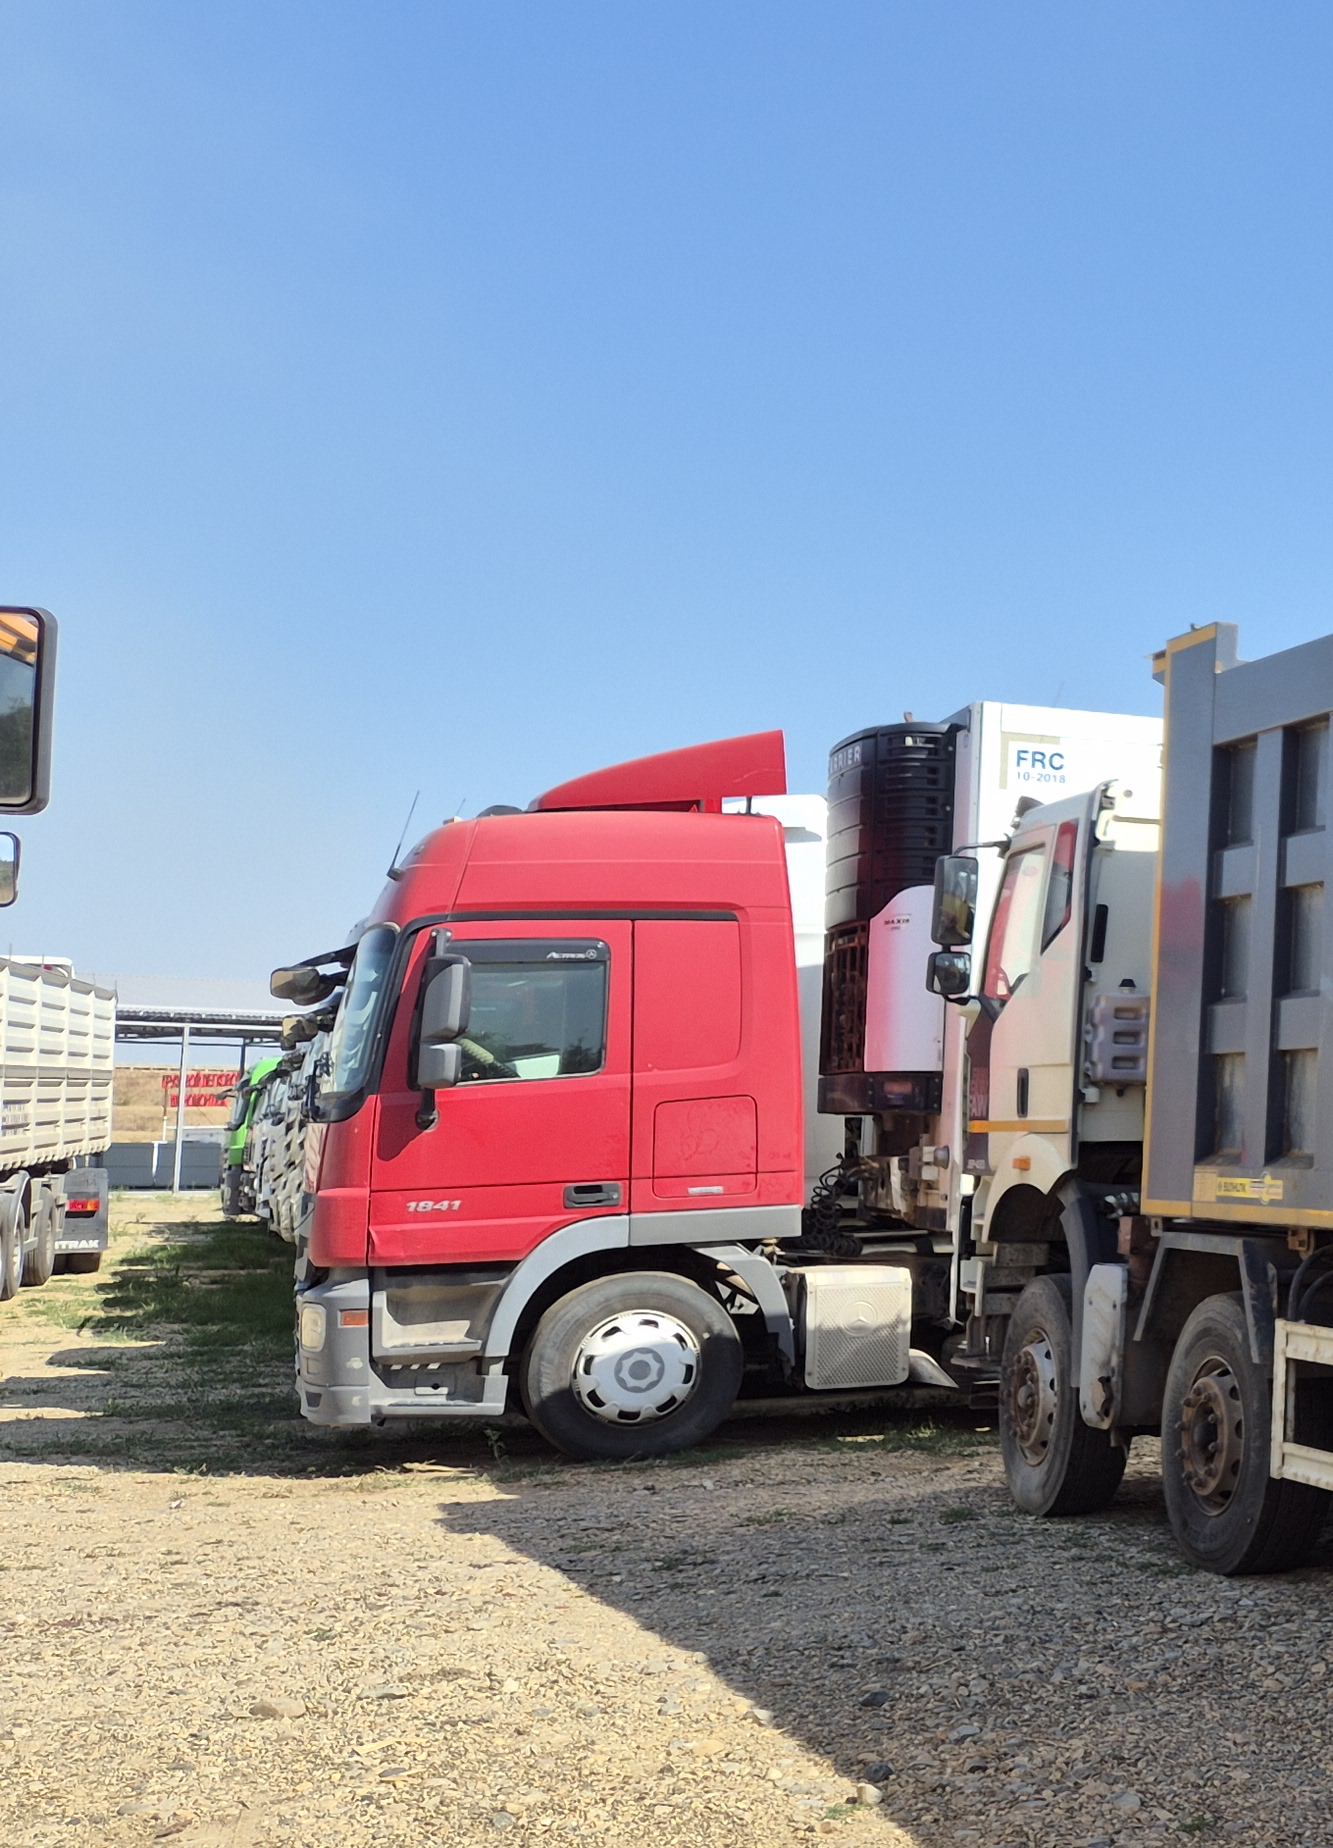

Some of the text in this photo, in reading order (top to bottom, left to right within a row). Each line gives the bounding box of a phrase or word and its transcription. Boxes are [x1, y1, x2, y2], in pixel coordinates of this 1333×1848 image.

[1015, 749, 1066, 771] FRC
[1016, 770, 1067, 784] 10-2018
[405, 1200, 462, 1213] 1841
